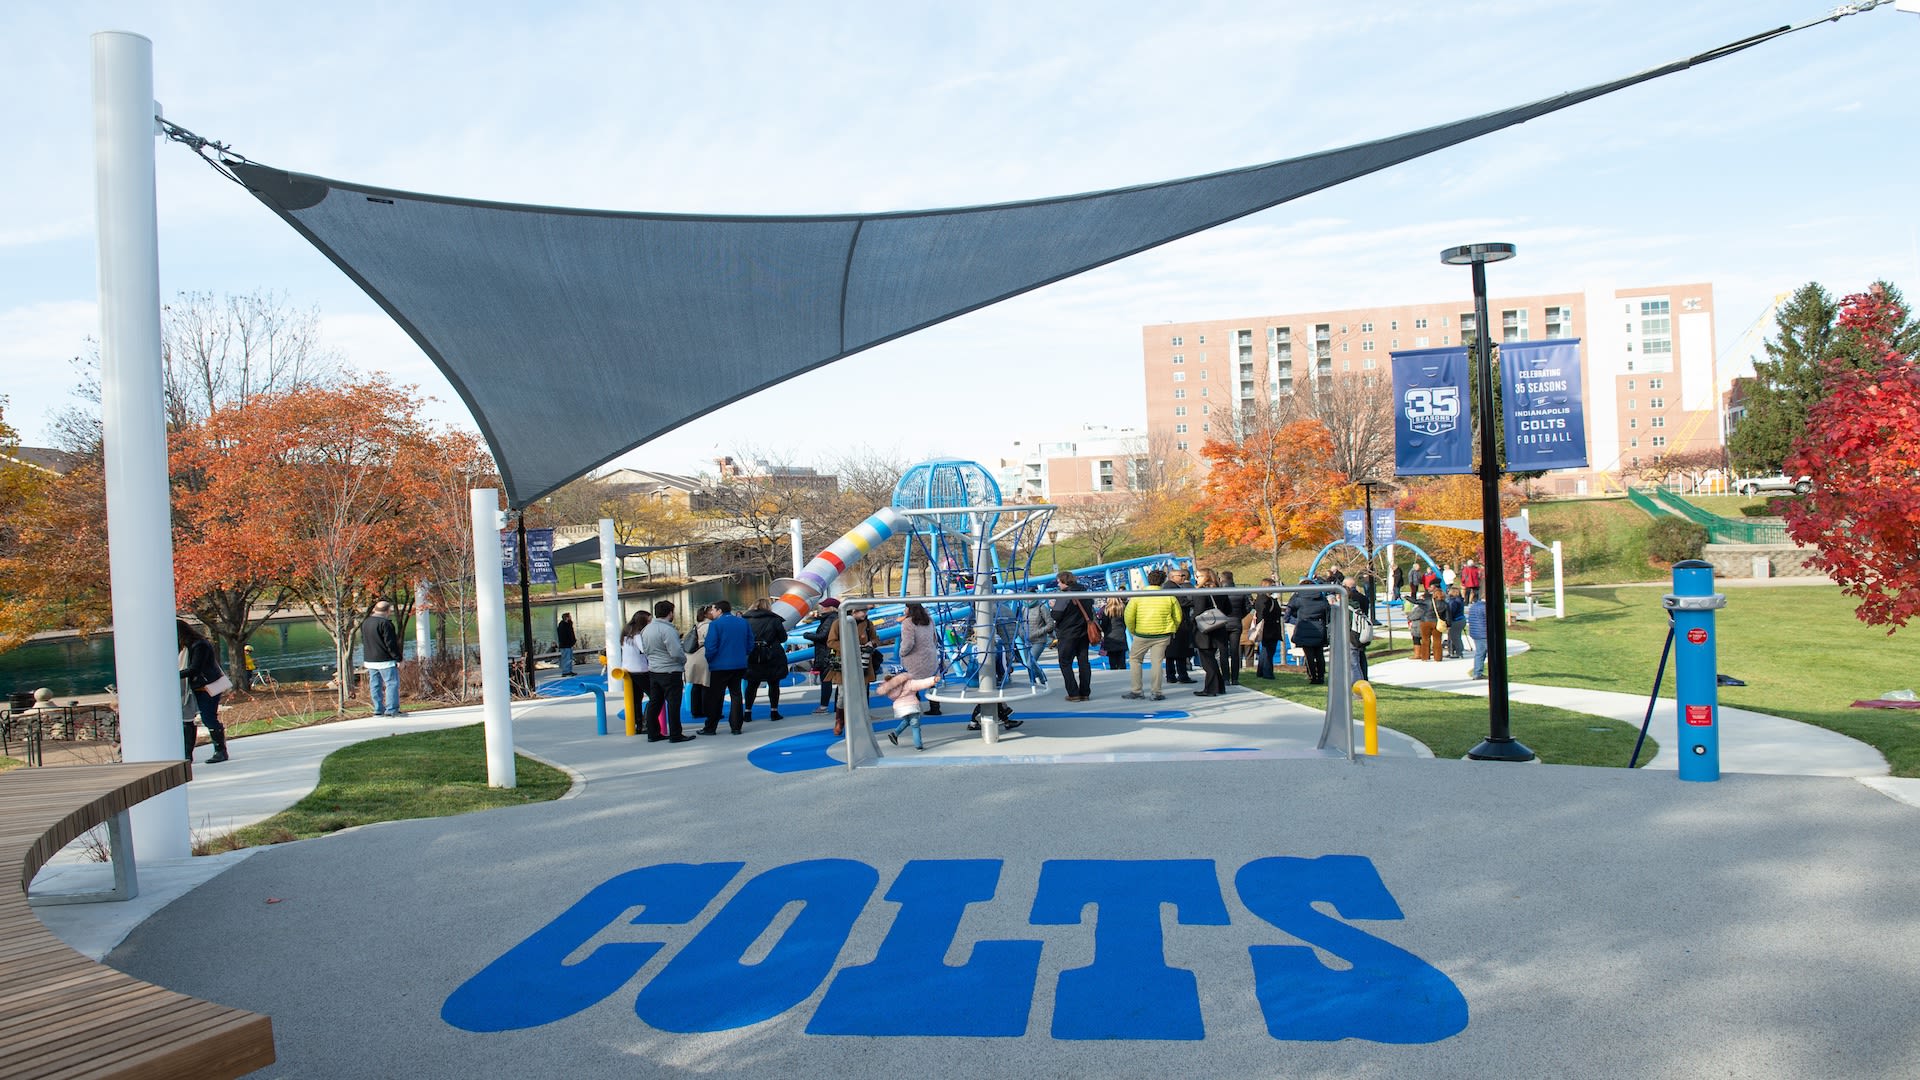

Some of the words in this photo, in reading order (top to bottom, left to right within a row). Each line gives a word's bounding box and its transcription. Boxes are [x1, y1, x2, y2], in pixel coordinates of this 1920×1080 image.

[1519, 368, 1561, 379] CELEBRATING
[1515, 383, 1526, 394] 35
[1528, 380, 1567, 393] SEASONS
[1406, 388, 1459, 417] 35
[1514, 408, 1571, 417] INDIANAPOLIS
[1521, 419, 1566, 431] COLTS
[1517, 432, 1572, 445] FOOTBALL
[440, 854, 1469, 1045] COLTS
